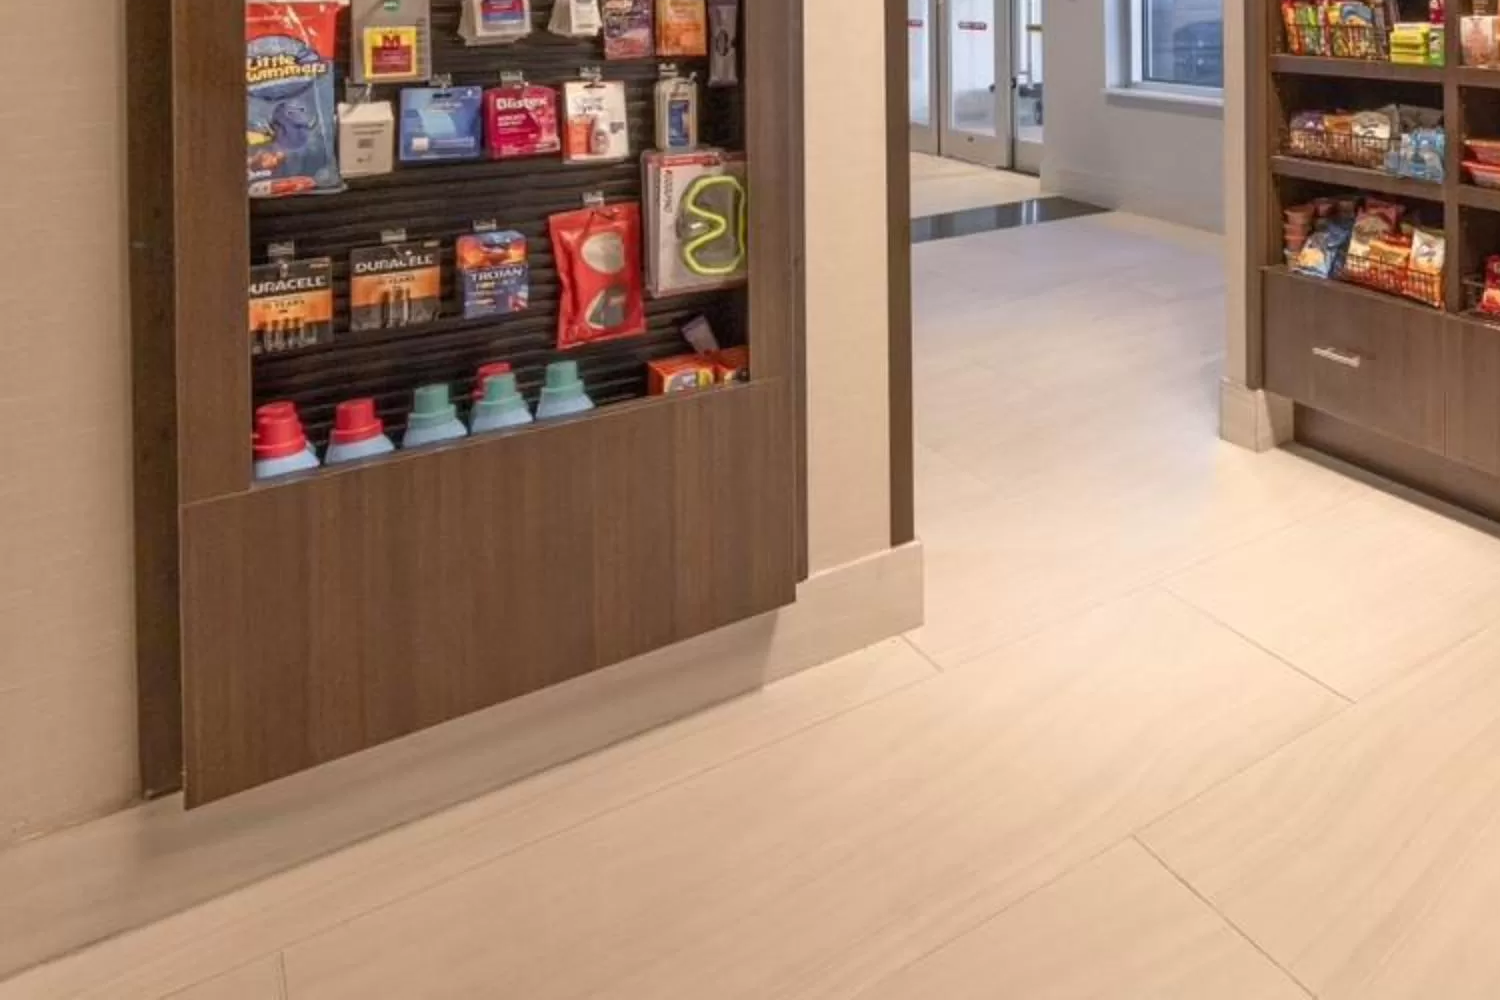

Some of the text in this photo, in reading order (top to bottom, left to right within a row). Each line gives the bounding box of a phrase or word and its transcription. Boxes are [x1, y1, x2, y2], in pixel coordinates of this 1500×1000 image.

[246, 54, 297, 71] Little
[246, 63, 328, 83] wimmers
[354, 253, 433, 273] DURACELL
[249, 275, 327, 295] URACELL
